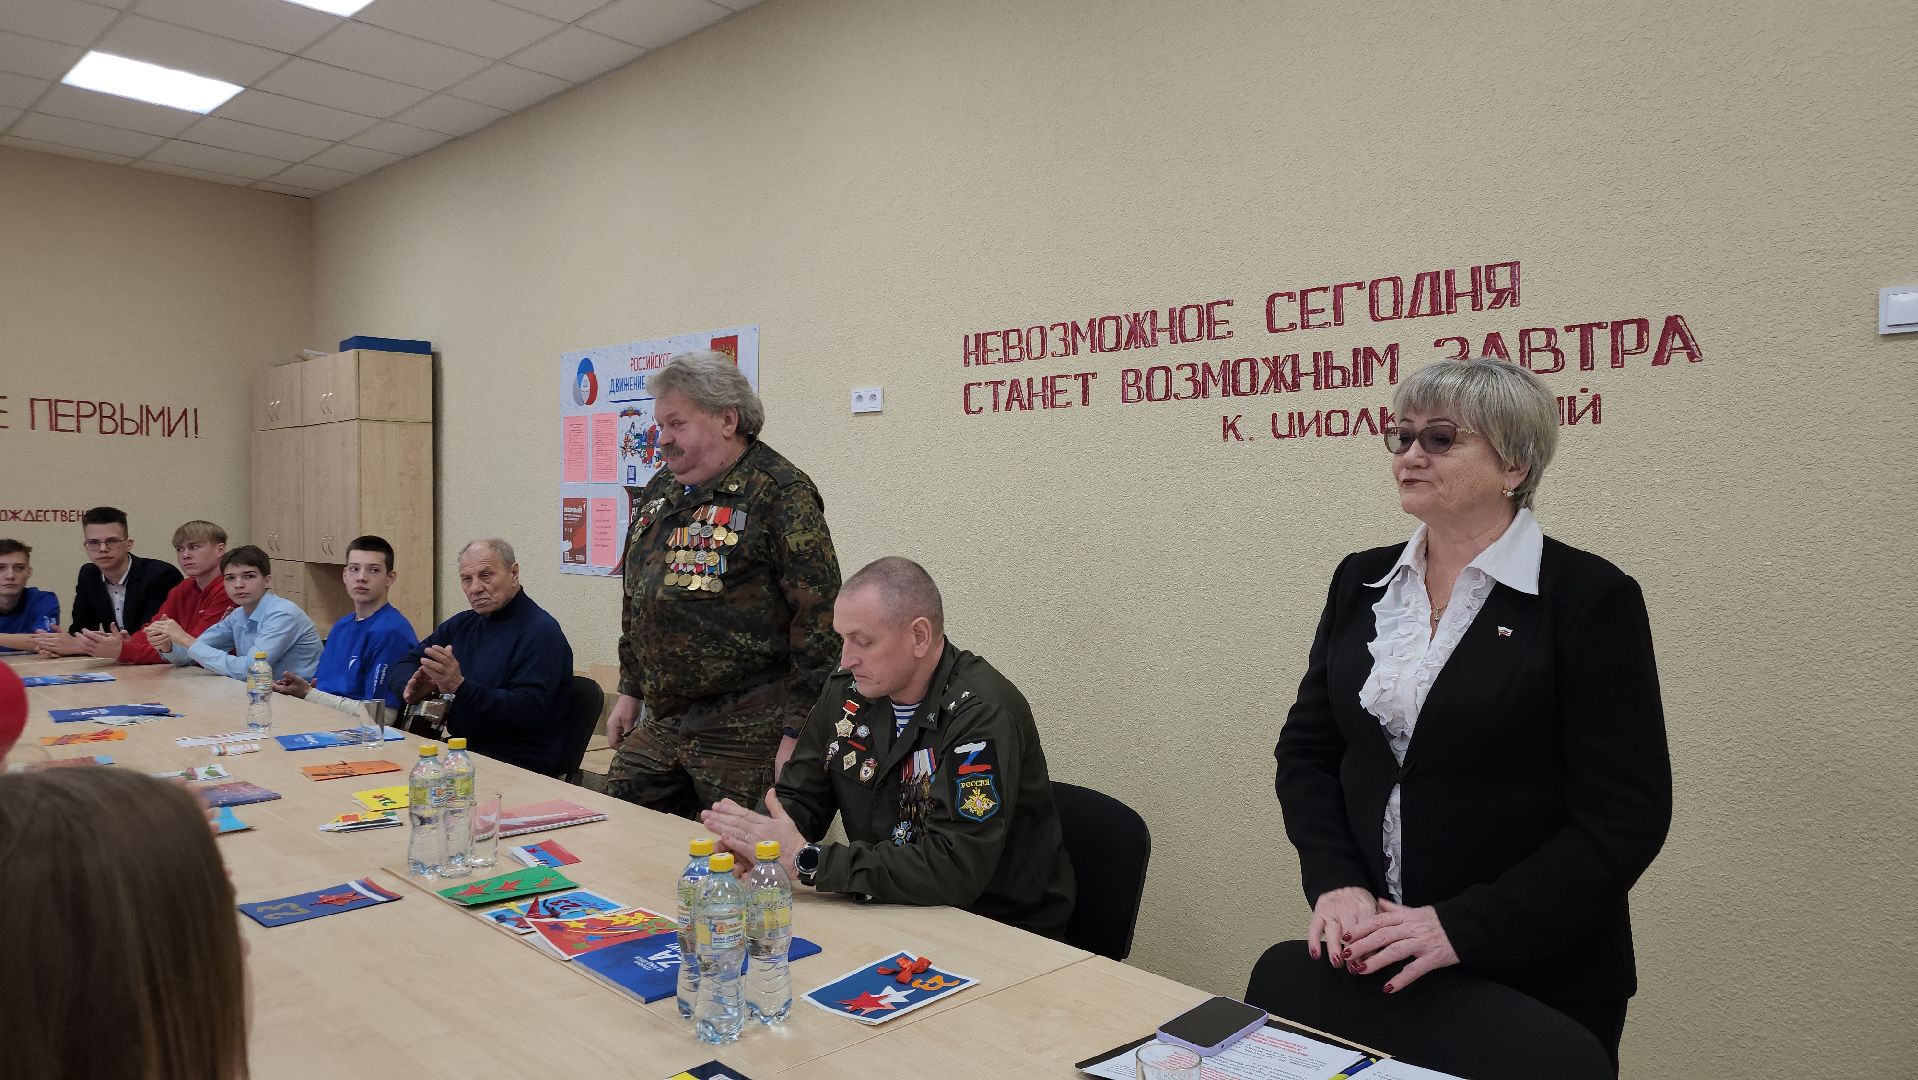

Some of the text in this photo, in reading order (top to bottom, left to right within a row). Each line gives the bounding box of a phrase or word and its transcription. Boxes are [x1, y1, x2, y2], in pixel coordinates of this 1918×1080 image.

[963, 260, 1522, 367] НЕВОЗМОЖНОЕ СЕГОДНЯ
[963, 313, 1704, 416] СТАНЕТ ВОЗМОЖНЫМ ЗАВТРА
[609, 375, 646, 395] ДВИЖЕНИЕ
[30, 397, 200, 439] ПЕРВЫМИ!
[1222, 414, 1255, 442] К.
[960, 778, 991, 789] РОССИЯ
